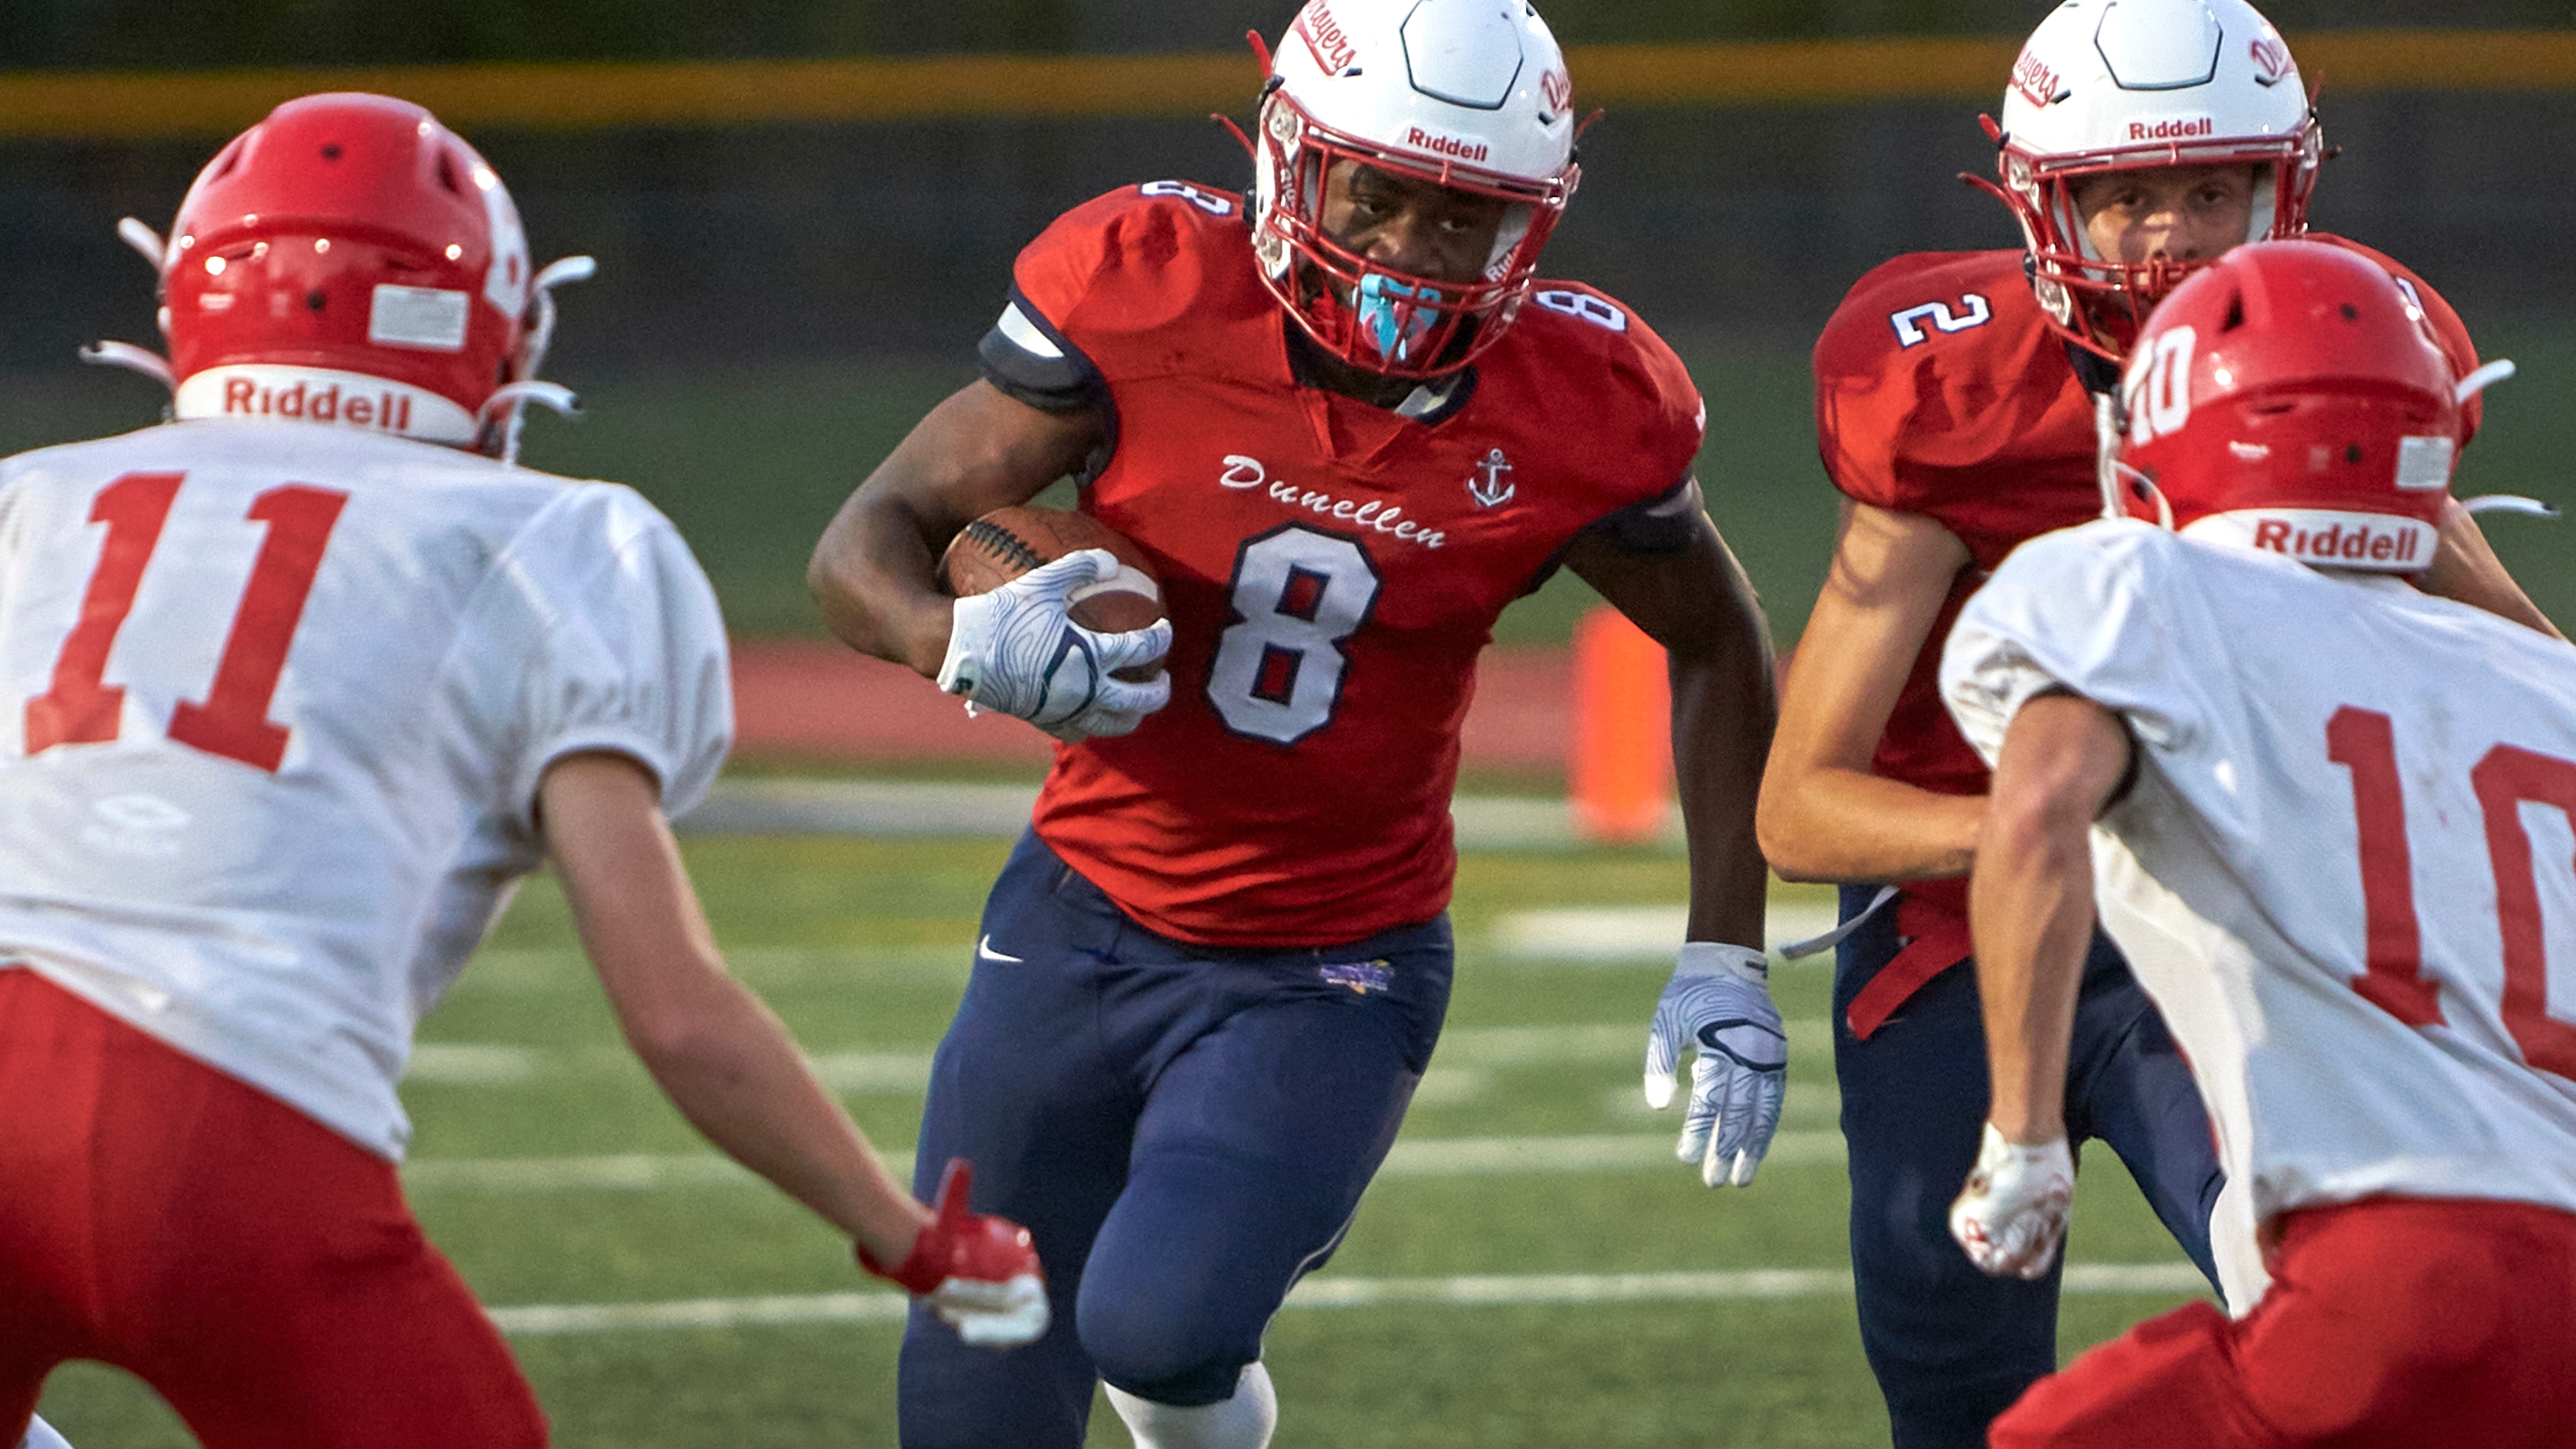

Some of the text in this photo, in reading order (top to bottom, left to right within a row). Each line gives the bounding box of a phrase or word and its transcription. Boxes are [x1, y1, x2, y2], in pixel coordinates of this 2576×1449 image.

[1408, 127, 1488, 162] Riddell
[2129, 117, 2212, 140] Riddell
[1140, 179, 1233, 216] 8
[1529, 289, 1629, 334] 8
[1888, 293, 1993, 351] 2
[224, 376, 412, 430] Riddell
[1220, 454, 1446, 549] Dunellen
[2254, 517, 2419, 562] Riddell
[24, 471, 351, 774] 11
[1205, 521, 1386, 748] 8
[2326, 702, 2576, 1082] 10
